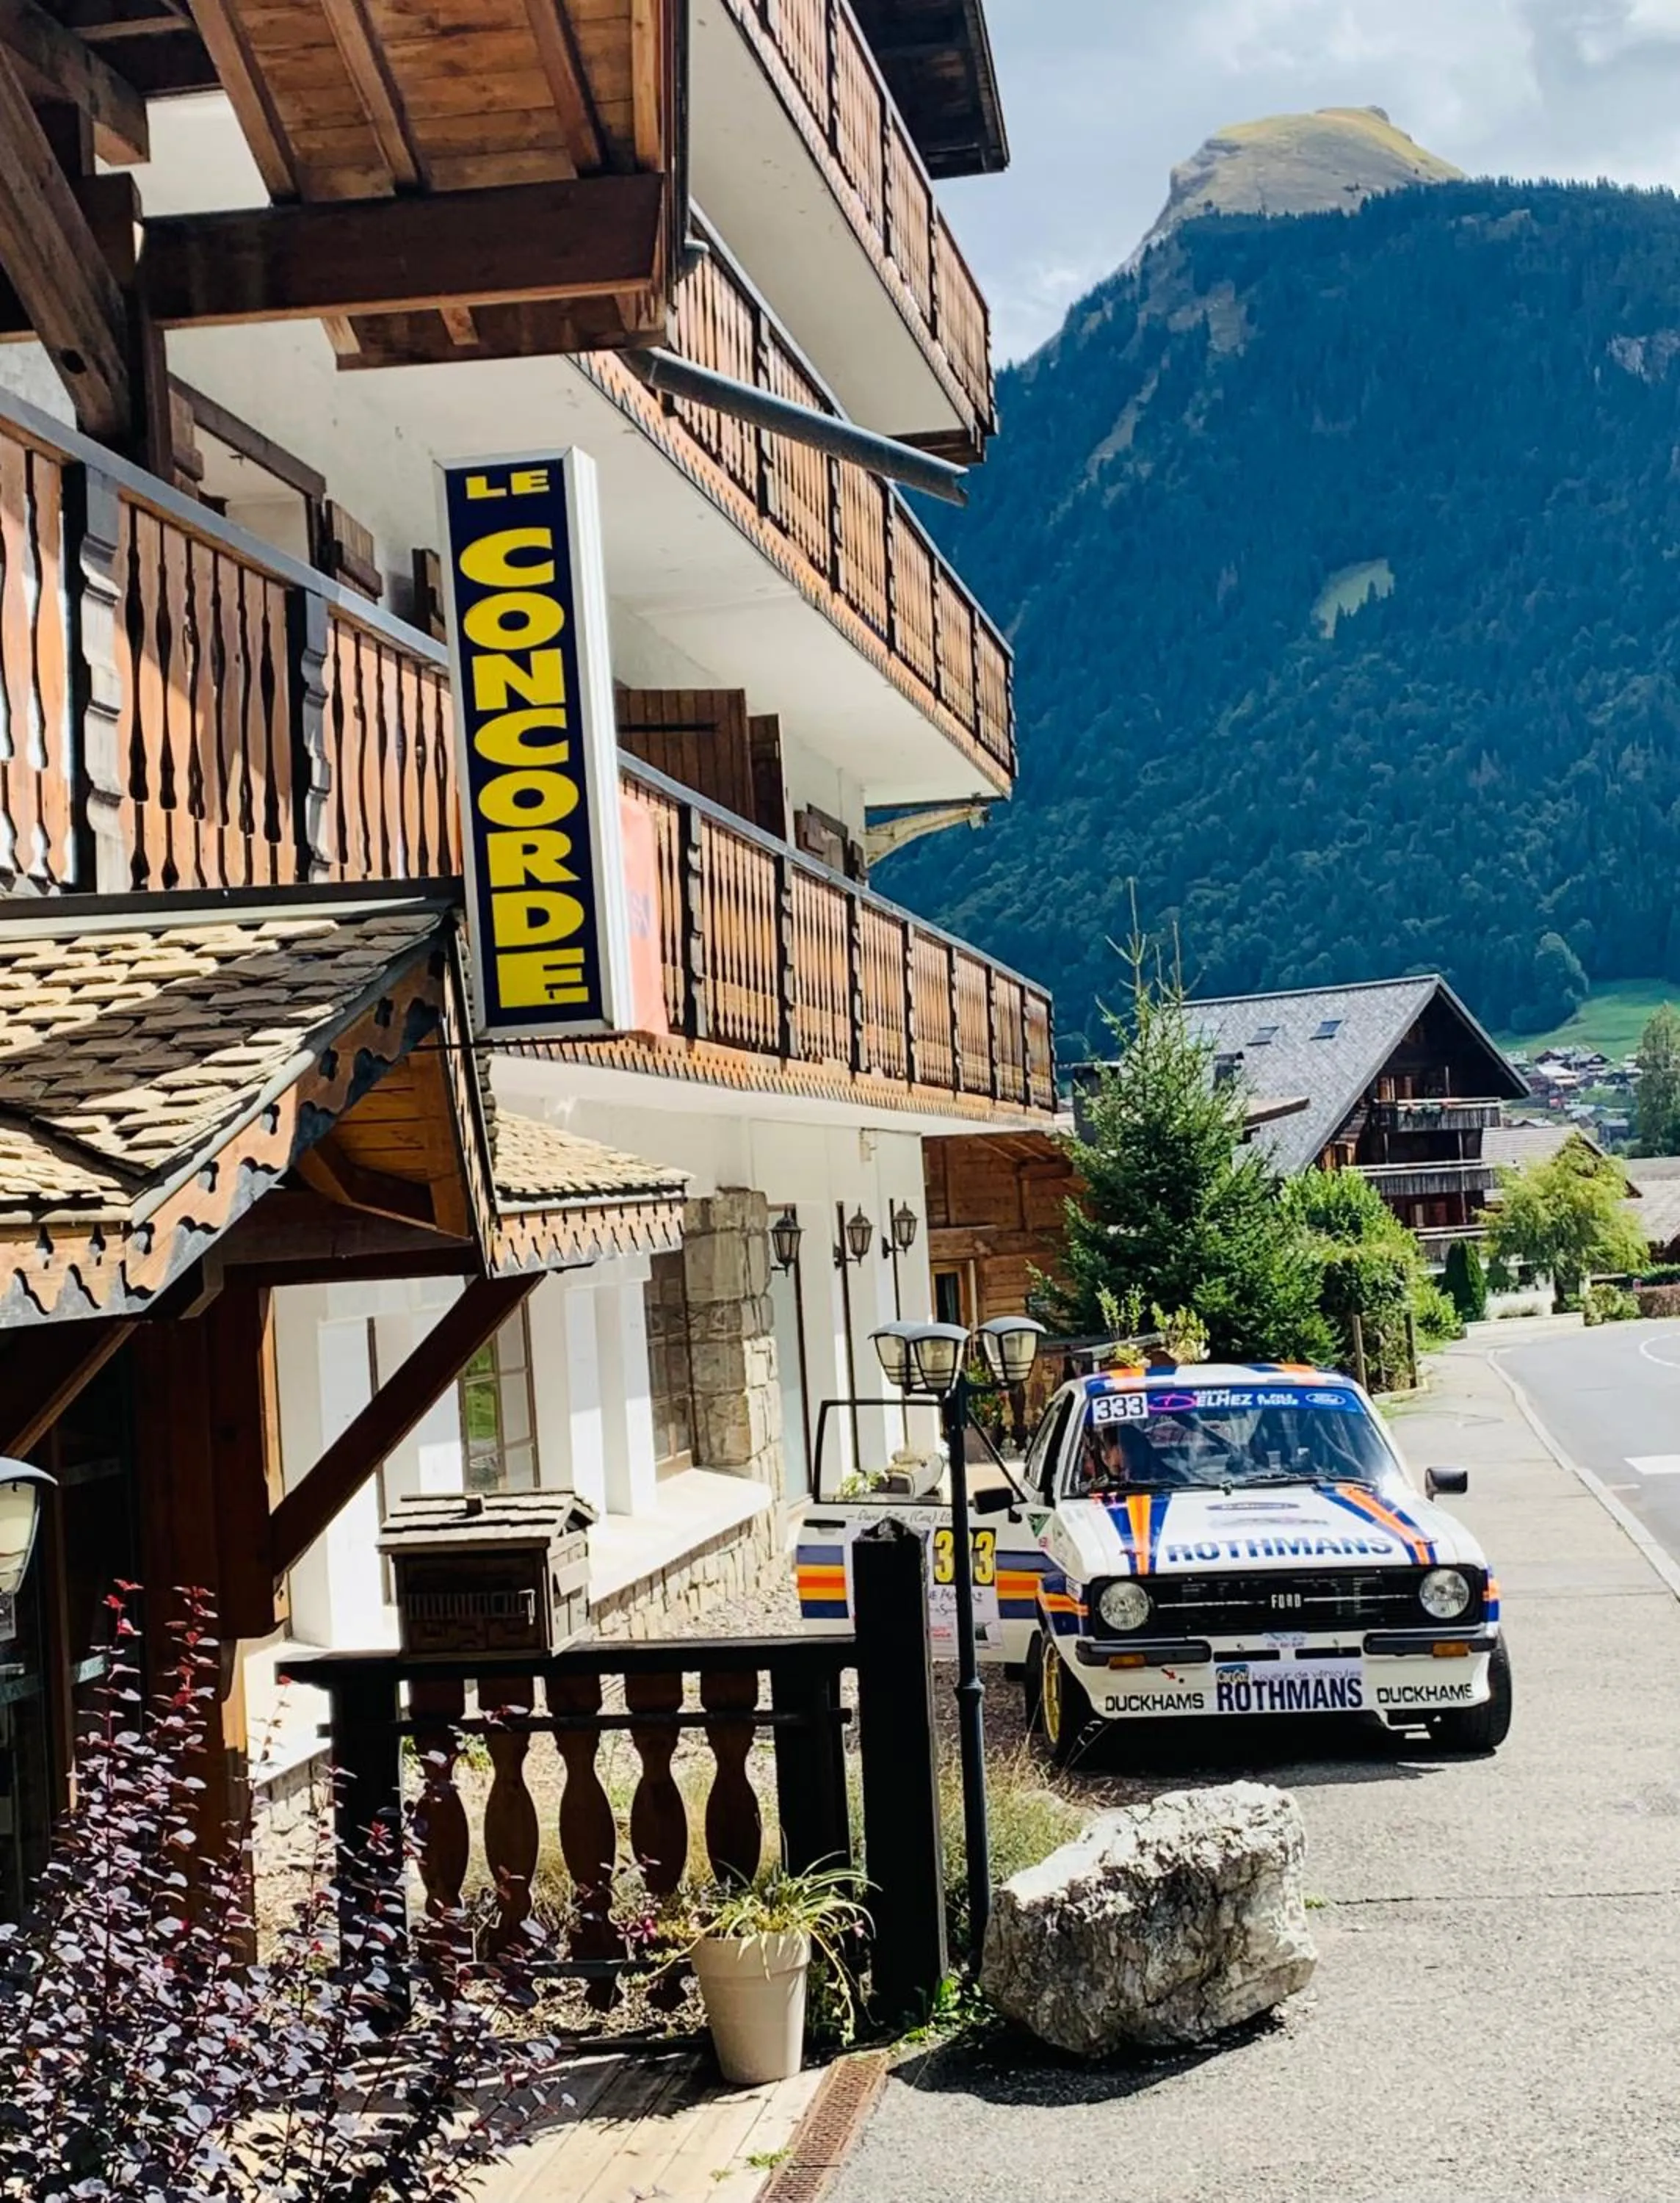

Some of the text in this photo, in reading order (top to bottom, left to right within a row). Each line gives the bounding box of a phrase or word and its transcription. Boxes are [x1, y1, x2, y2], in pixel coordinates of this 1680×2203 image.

[466, 469, 550, 500] LE
[459, 527, 590, 1008] CONCORDE
[1096, 1396, 1144, 1420] 333
[934, 1529, 995, 1585] 33
[1165, 1536, 1394, 1563] ROTHMANS
[1270, 1593, 1302, 1609] FORD
[1105, 1692, 1204, 1712] DUCKHAMS
[1217, 1678, 1364, 1712] ROTHMANS
[1377, 1684, 1473, 1704] DUCKHAMS
